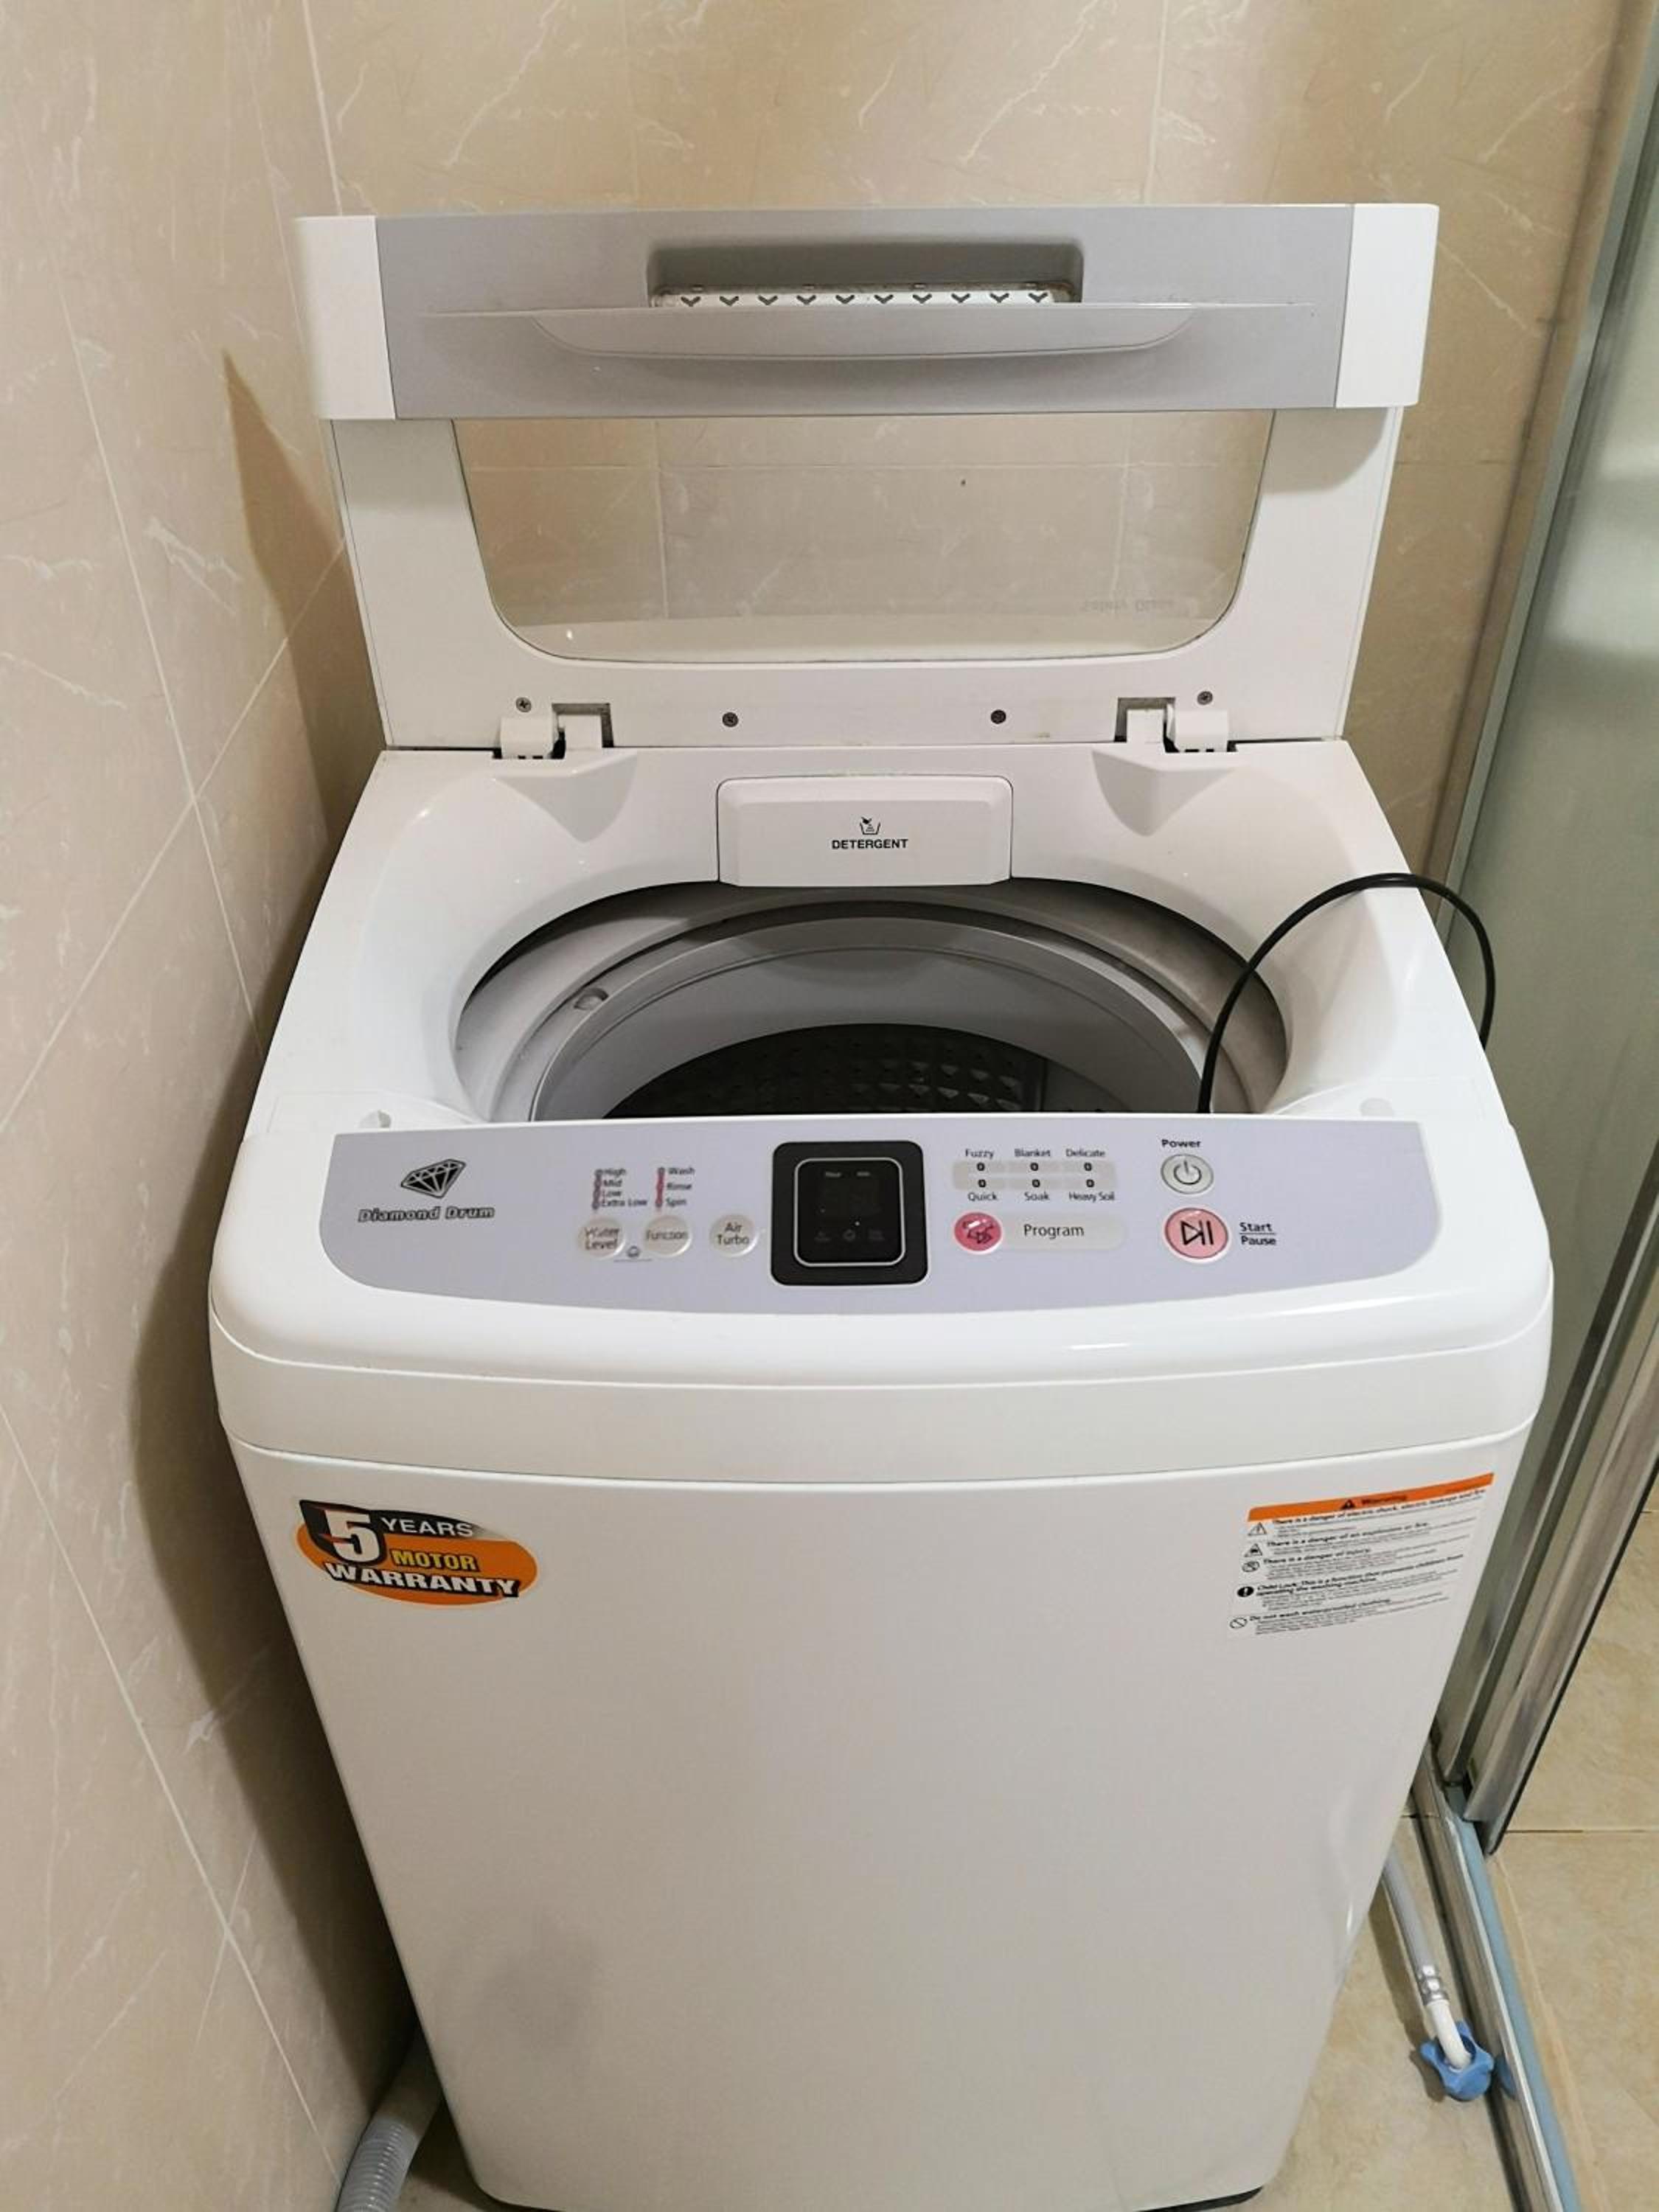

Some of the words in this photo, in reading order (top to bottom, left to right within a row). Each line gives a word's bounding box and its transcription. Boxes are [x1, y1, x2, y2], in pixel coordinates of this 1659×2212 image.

[831, 838, 908, 849] DETERGENT
[1161, 1138, 1201, 1148] Power
[965, 1148, 995, 1159] Fuzzy
[1015, 1148, 1051, 1158] Blanket
[1066, 1148, 1105, 1158] Delicate
[669, 1166, 695, 1175] Wash
[967, 1192, 997, 1202] Quick
[1024, 1192, 1050, 1201] Soak
[1069, 1192, 1096, 1202] Heavy
[1099, 1192, 1115, 1201] Soil
[358, 1206, 441, 1222] Diamond
[445, 1206, 495, 1220] Drum
[725, 1222, 743, 1233] Air
[1023, 1224, 1085, 1239] Program
[1239, 1222, 1273, 1232] Start
[717, 1234, 750, 1245] Turbo
[1241, 1235, 1276, 1245] Pause
[324, 1509, 380, 1563] 5
[380, 1517, 474, 1537] YEARS
[392, 1549, 478, 1571] MOTOR
[324, 1562, 518, 1595] WARRANTY
